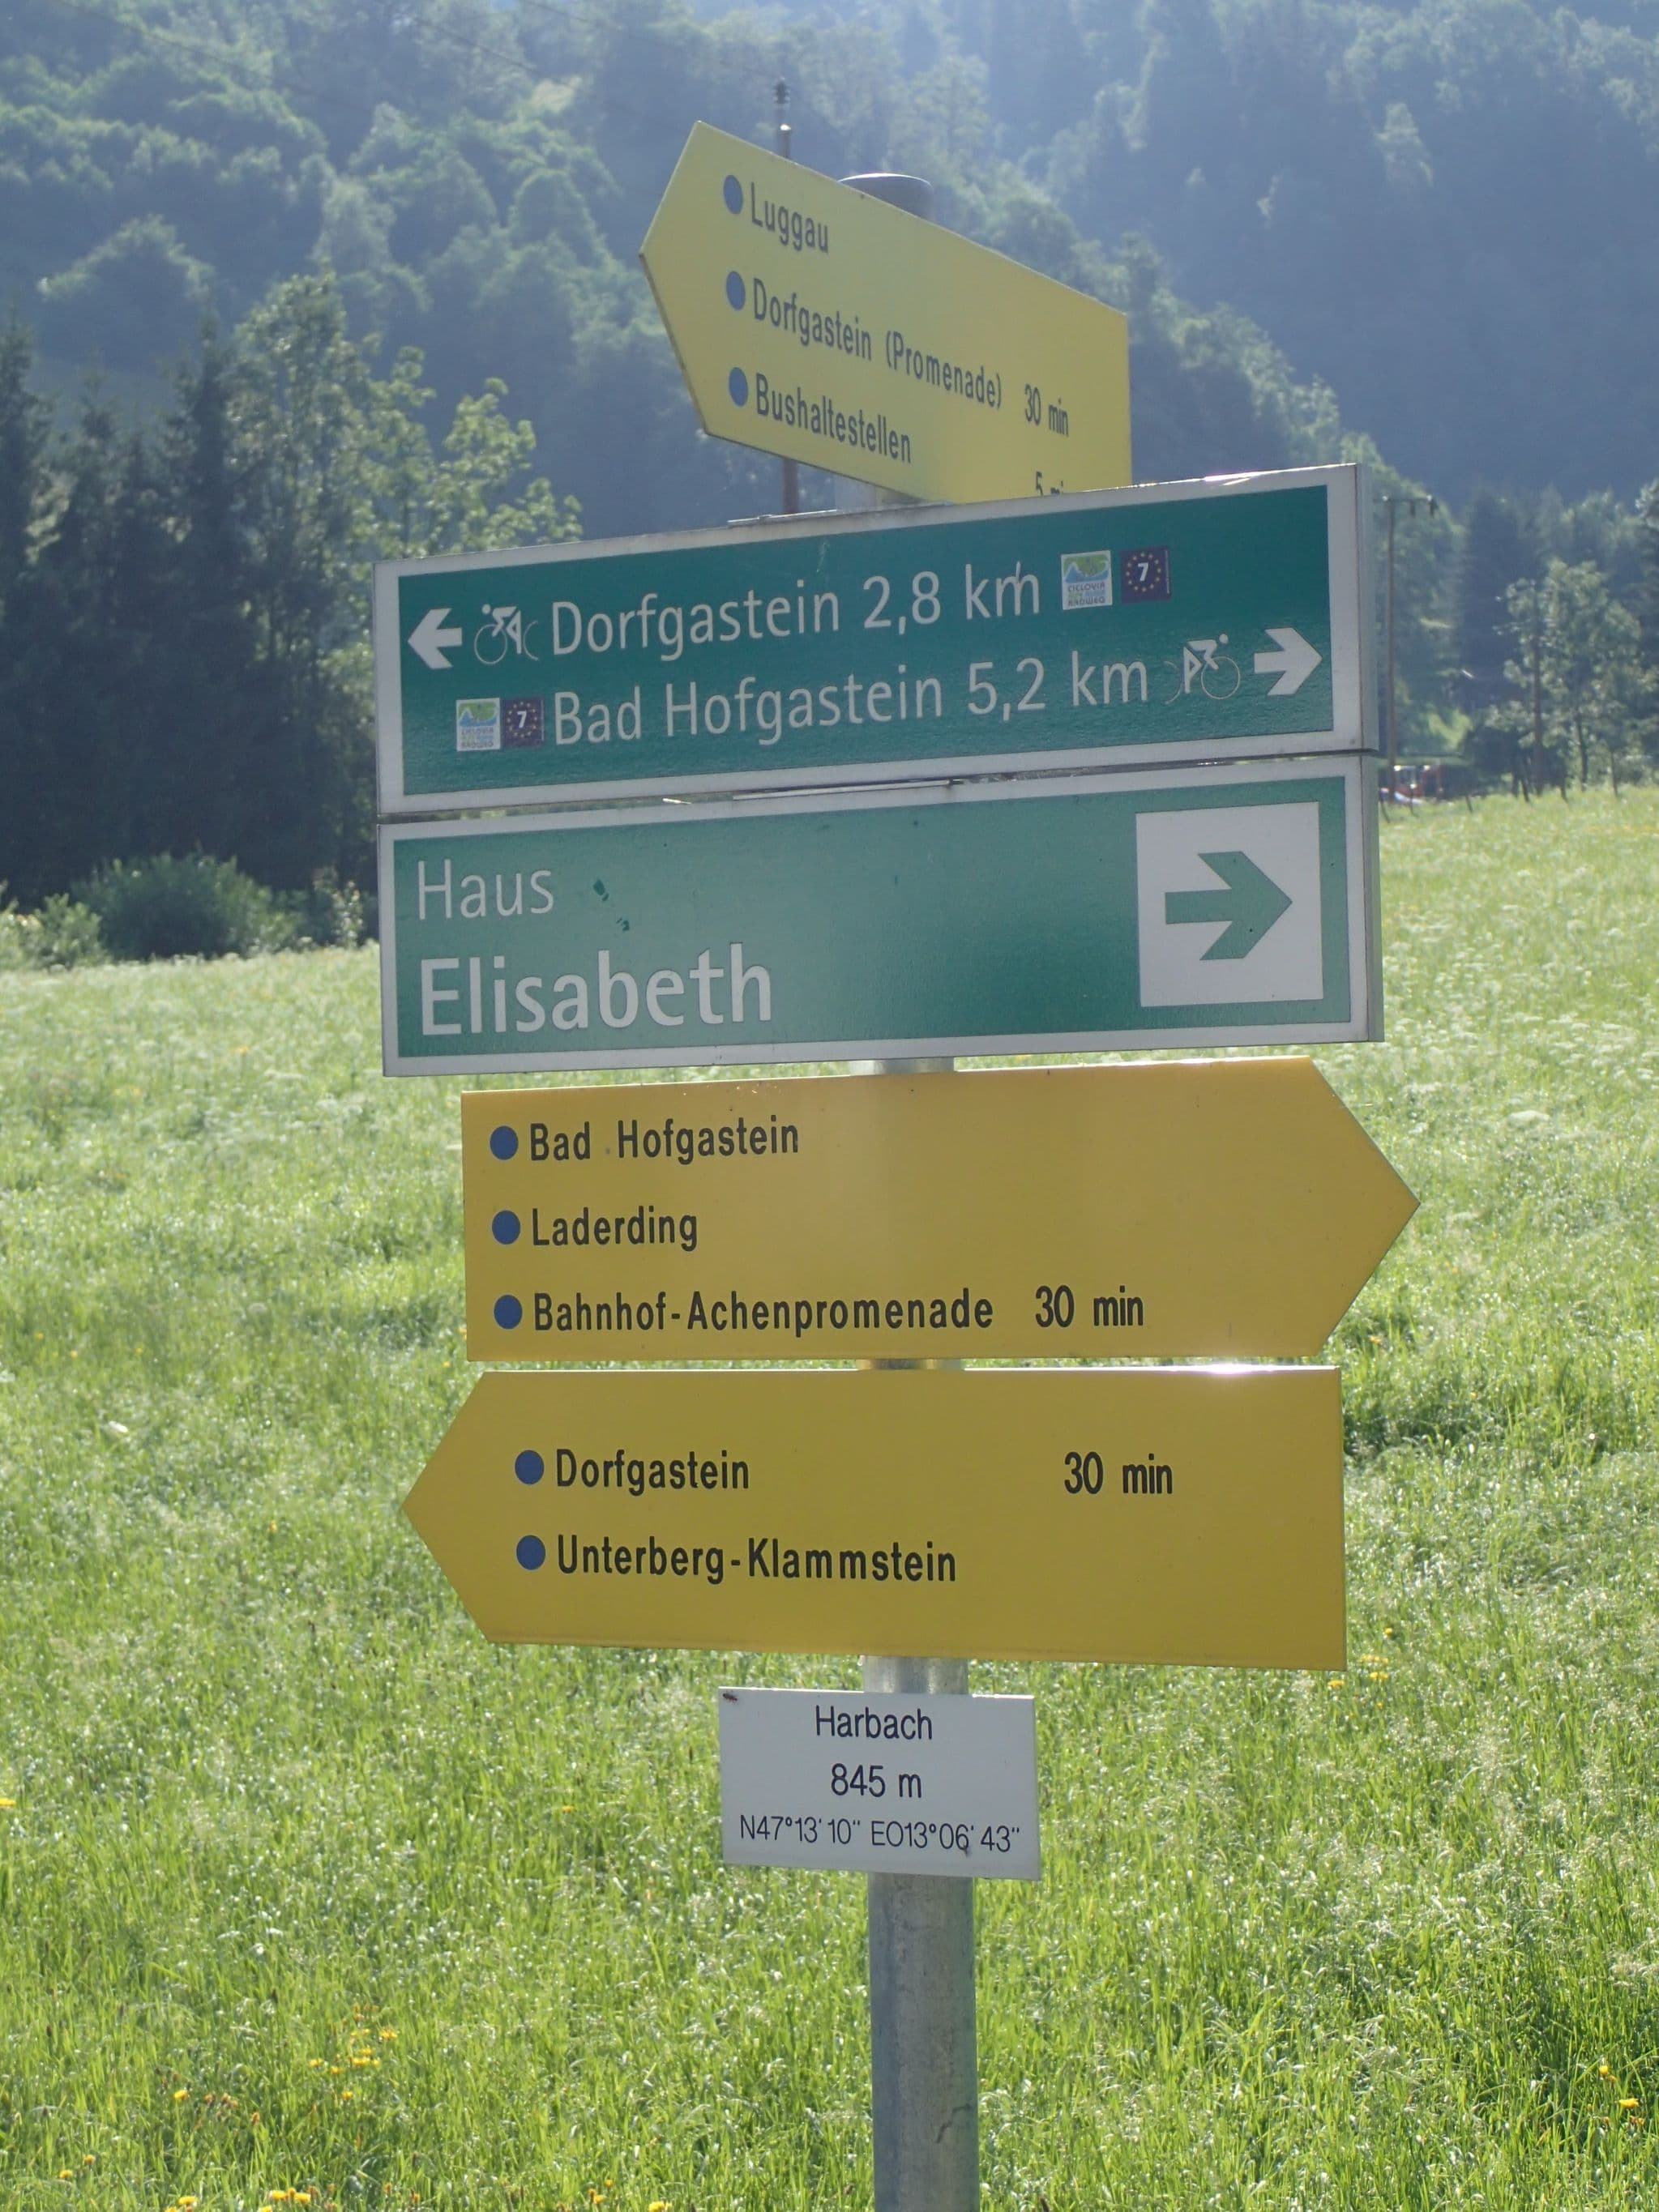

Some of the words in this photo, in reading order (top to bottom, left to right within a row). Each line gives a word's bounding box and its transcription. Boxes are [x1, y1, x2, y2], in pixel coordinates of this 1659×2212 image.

[750, 182, 829, 254] Luggau
[753, 277, 872, 361] Dorfgastein
[885, 330, 1003, 409] (Promenade)
[1024, 384, 1041, 425] 30
[1049, 398, 1069, 438] min
[755, 372, 912, 463] Bushaltestellen
[1138, 562, 1148, 582] 7
[553, 579, 839, 662] Dorfgastein
[864, 571, 940, 635] 2,8
[966, 562, 1040, 620] km
[517, 711, 527, 728] 7
[555, 685, 641, 746] Bad
[666, 664, 943, 745] Hofgastein
[968, 657, 1045, 721] 5,2
[1071, 651, 1148, 707] km
[417, 858, 554, 920] Haus
[421, 942, 772, 1036] Elisabeth
[529, 1121, 592, 1161] Bad
[617, 1115, 800, 1165] Hofgastein
[531, 1205, 698, 1253] Laderding
[533, 1287, 994, 1338] Bahnhof-Achenpromenade
[1034, 1285, 1075, 1329] 30
[1093, 1285, 1144, 1328] min
[555, 1448, 750, 1497] Dorfgastein
[1063, 1451, 1104, 1496] 30
[1122, 1452, 1174, 1496] min
[557, 1535, 956, 1585] Unterberg-Klammstein
[815, 1705, 932, 1740] Harbach
[831, 1762, 886, 1797] 845
[898, 1773, 922, 1798] m
